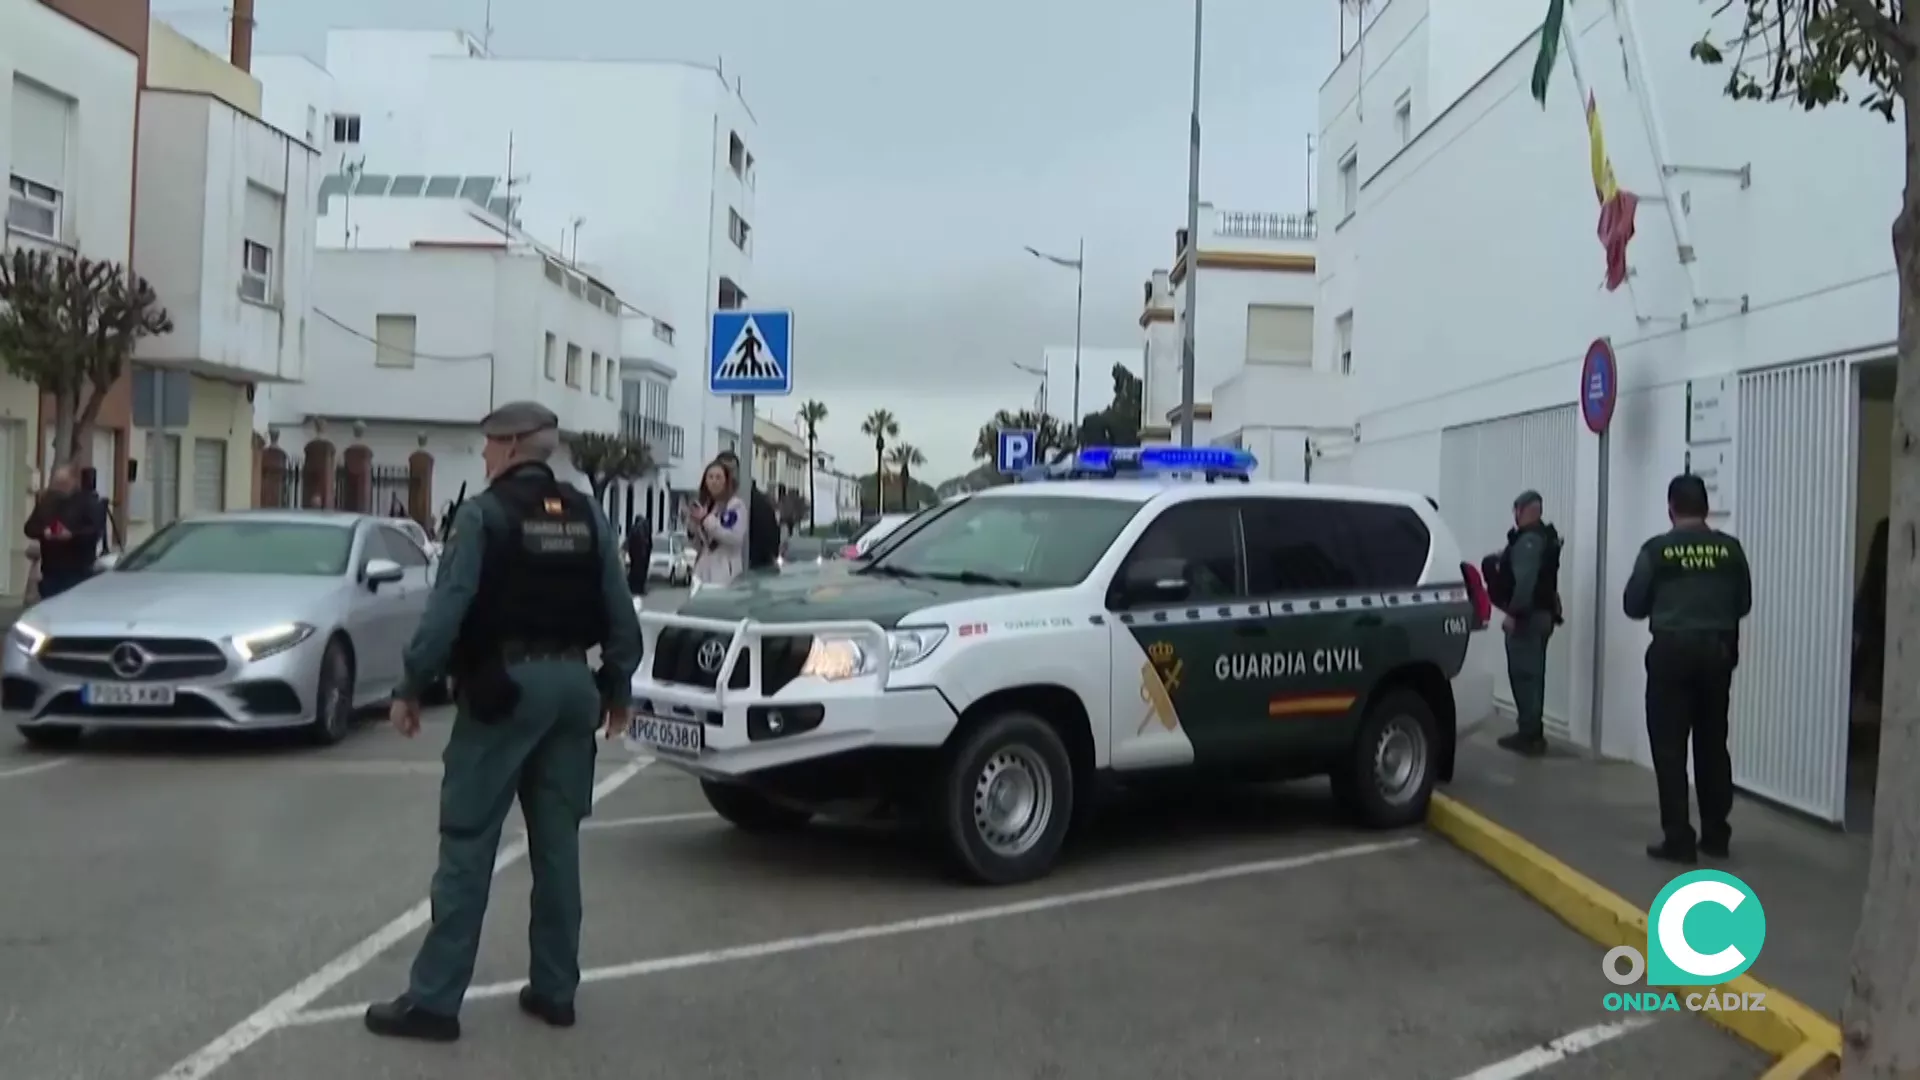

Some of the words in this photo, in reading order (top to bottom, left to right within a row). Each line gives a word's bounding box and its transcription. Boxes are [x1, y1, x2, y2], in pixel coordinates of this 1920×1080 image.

[1006, 435, 1028, 468] P
[1663, 545, 1729, 559] GUARDIA
[1680, 557, 1716, 569] CIVIL
[1215, 650, 1306, 680] GUARDIA
[1313, 647, 1363, 674] CIVIL
